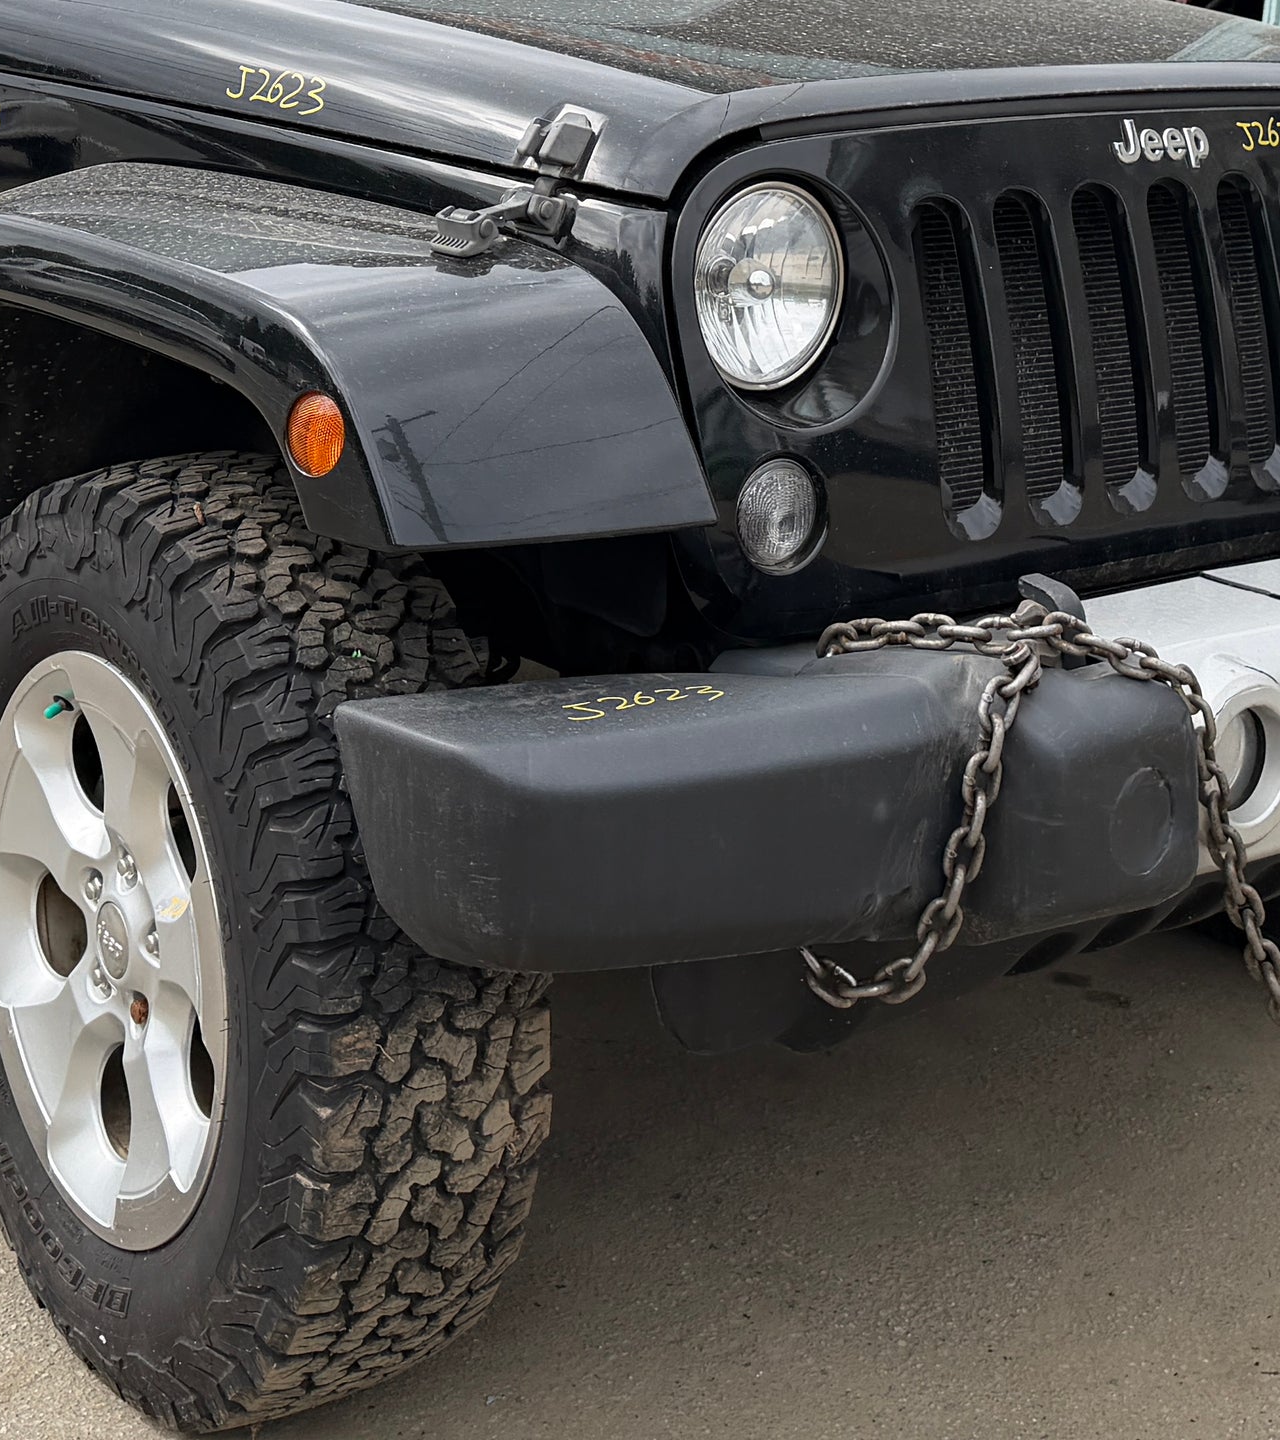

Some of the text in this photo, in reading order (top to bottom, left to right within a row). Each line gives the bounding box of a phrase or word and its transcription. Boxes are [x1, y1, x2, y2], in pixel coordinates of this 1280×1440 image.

[225, 65, 327, 116] J2623
[1112, 118, 1210, 169] Jeep
[561, 685, 725, 721] J2623
